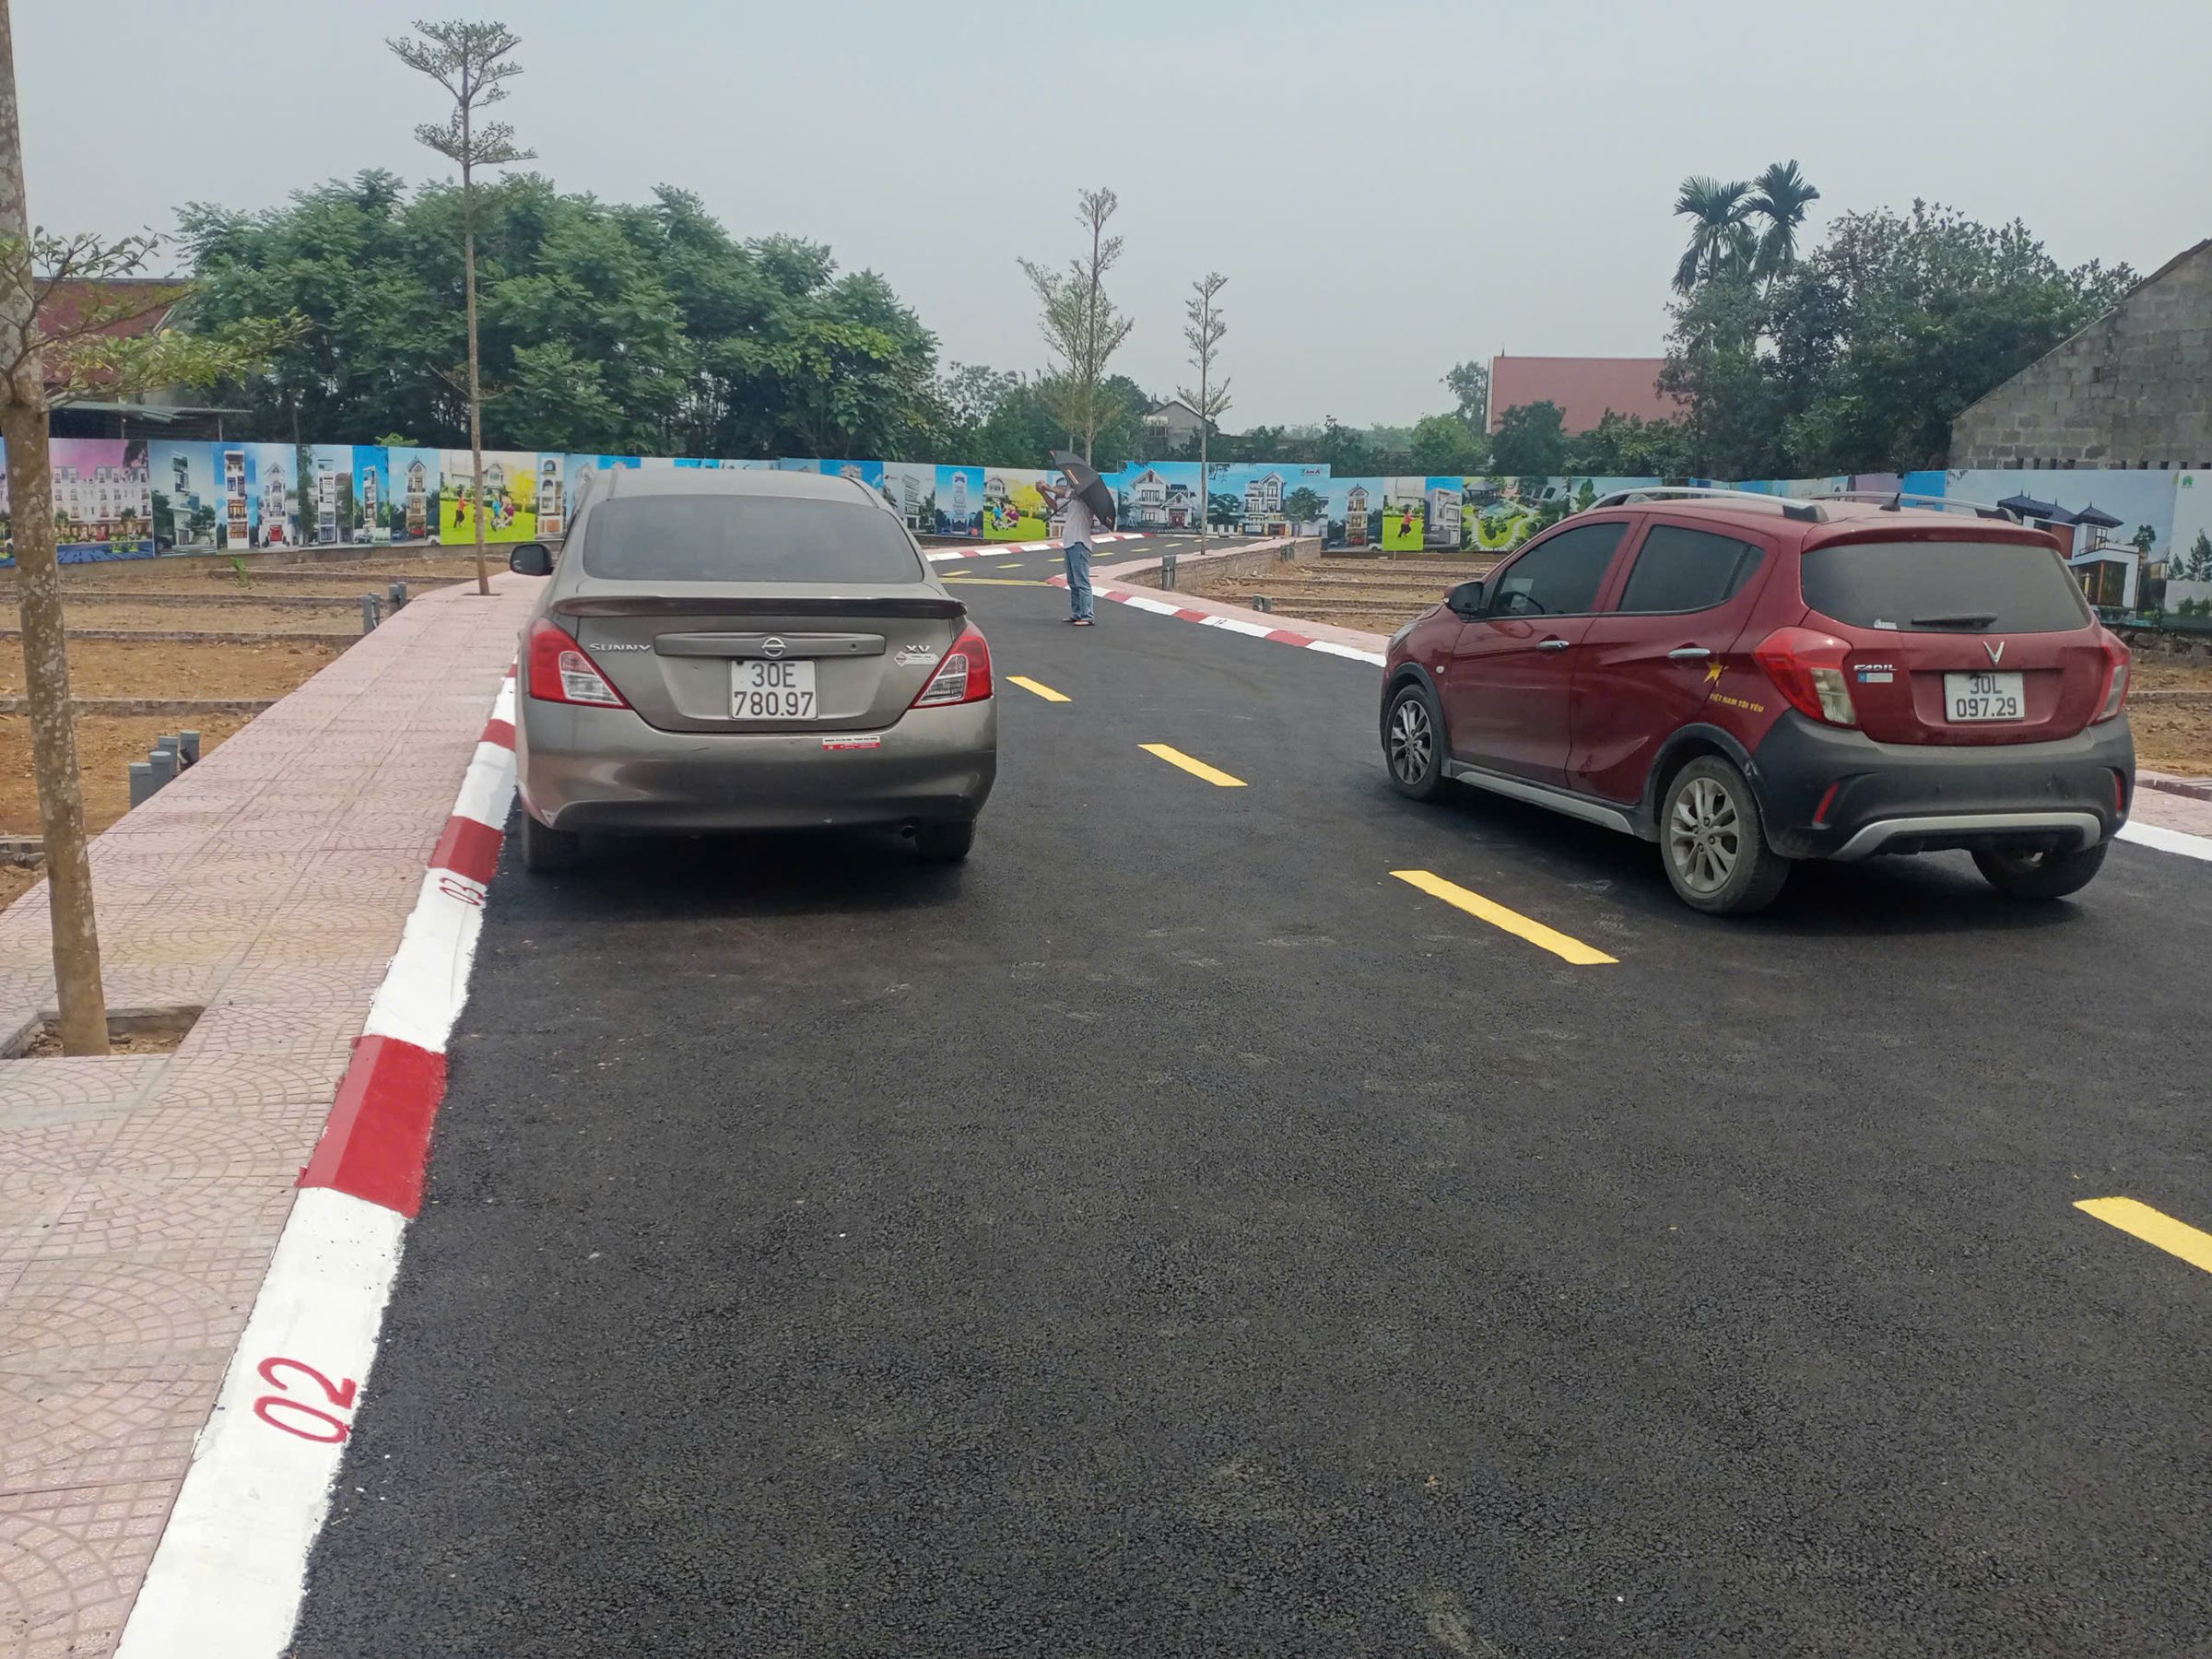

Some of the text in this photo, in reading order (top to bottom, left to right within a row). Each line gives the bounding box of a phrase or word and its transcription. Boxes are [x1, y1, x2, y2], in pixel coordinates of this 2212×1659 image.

[752, 663, 796, 688] 30E
[1970, 675, 2003, 694] 30L
[734, 690, 814, 716] 780.97
[1956, 697, 2017, 718] 097.29
[440, 877, 484, 906] 03
[253, 1351, 357, 1443] 02
